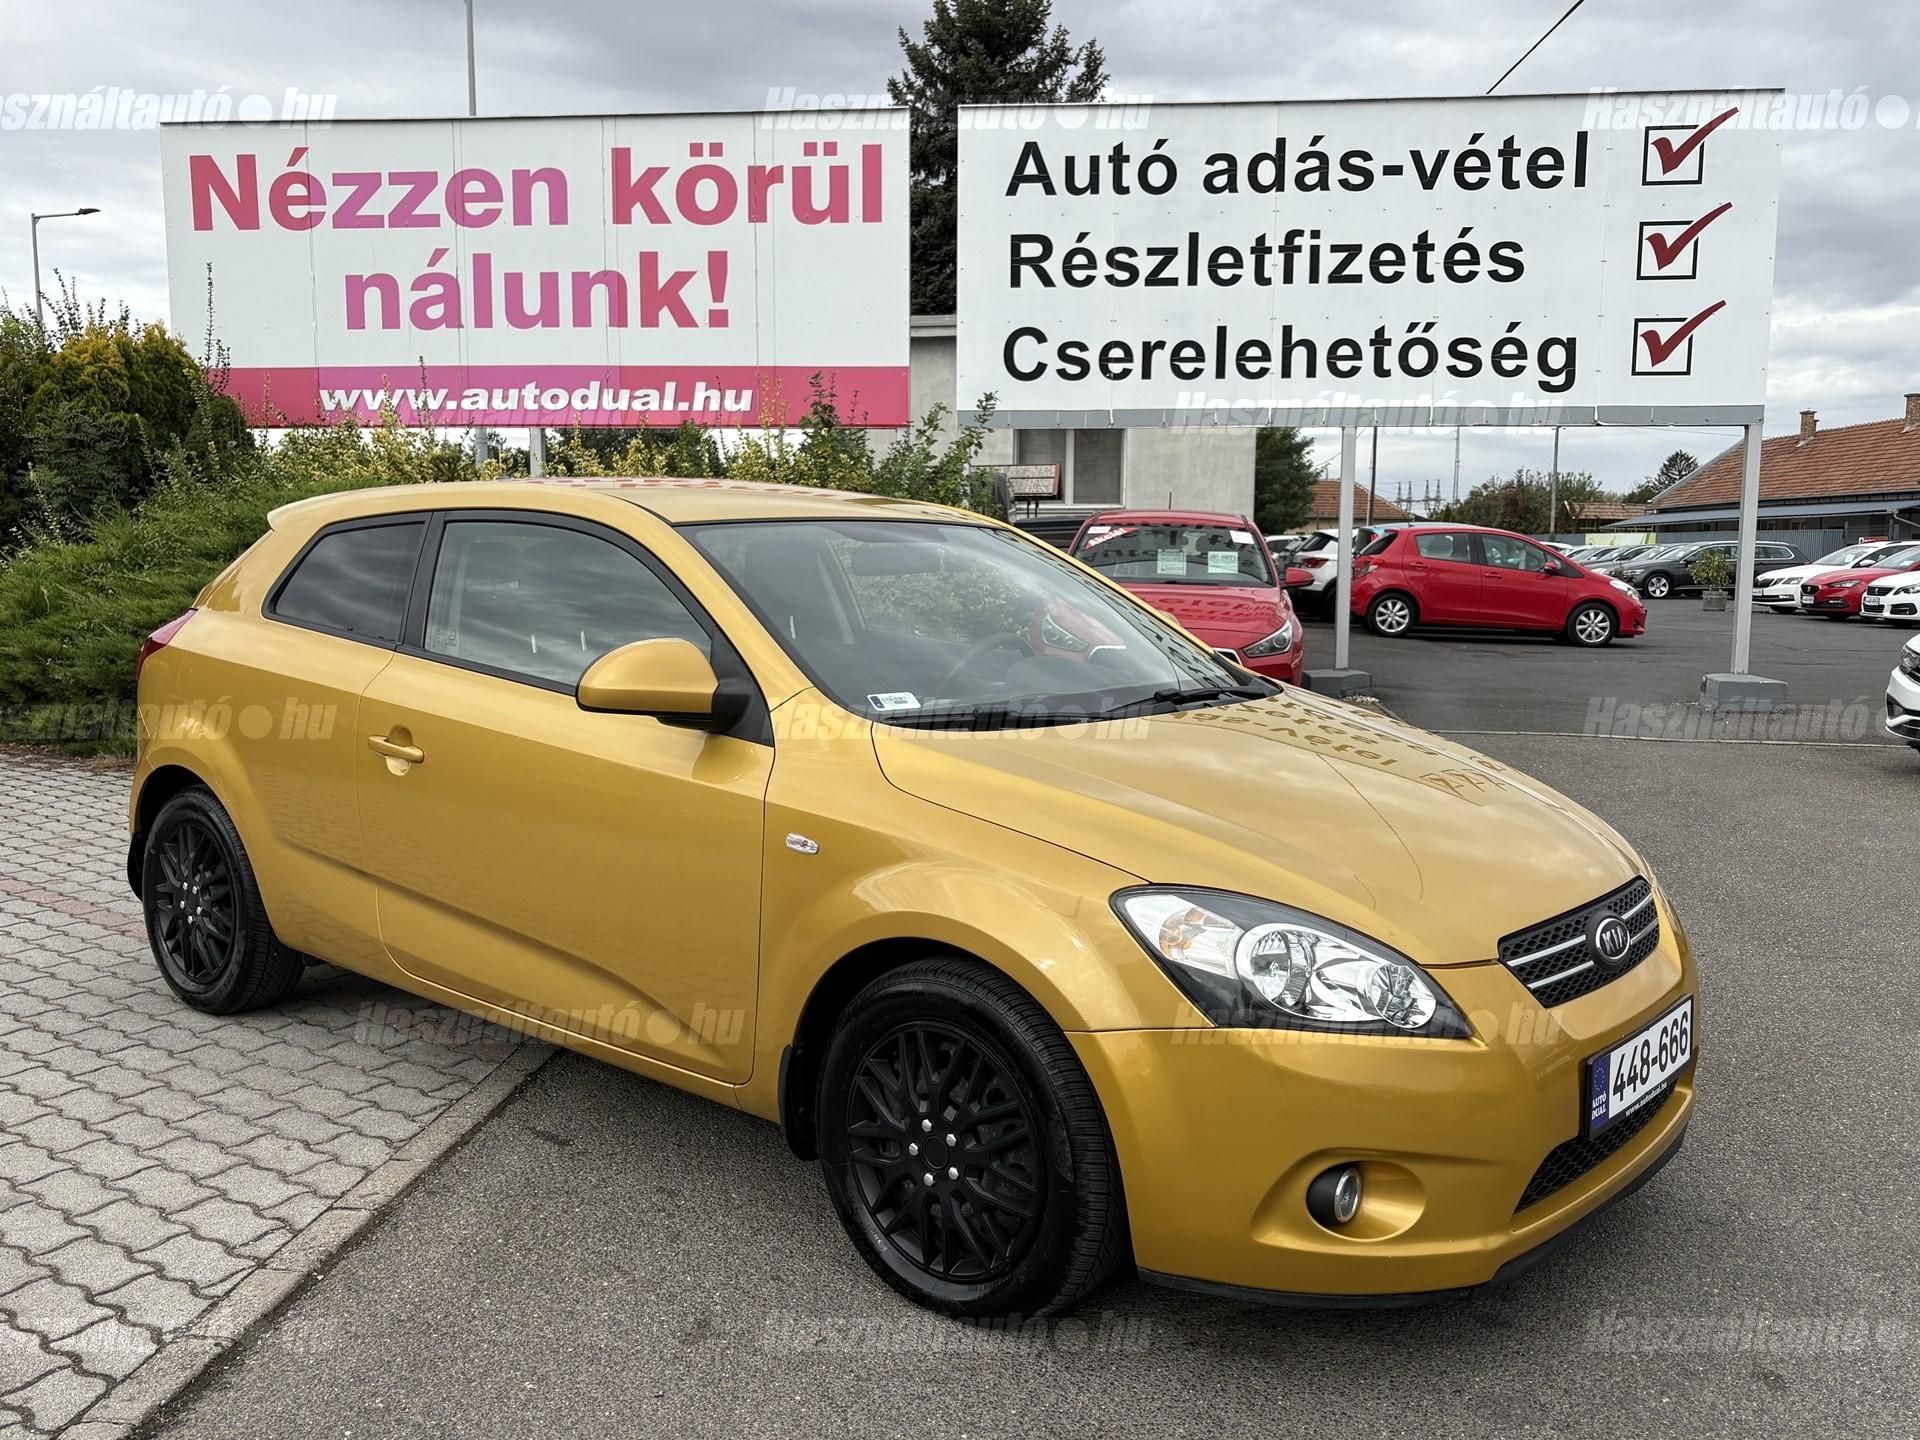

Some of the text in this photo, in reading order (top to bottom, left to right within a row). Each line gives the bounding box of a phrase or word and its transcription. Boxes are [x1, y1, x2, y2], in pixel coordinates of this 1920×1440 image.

[191, 142, 882, 231] Nézzen körül
[1006, 131, 1589, 196] Autó adás-vétel
[346, 250, 729, 330] nálunk!
[1010, 226, 1525, 289] Részletfizetés
[1003, 321, 1577, 393] Cserelehetőség
[320, 381, 753, 413] www.autodual.hu
[1612, 1010, 1689, 1103] 448-666
